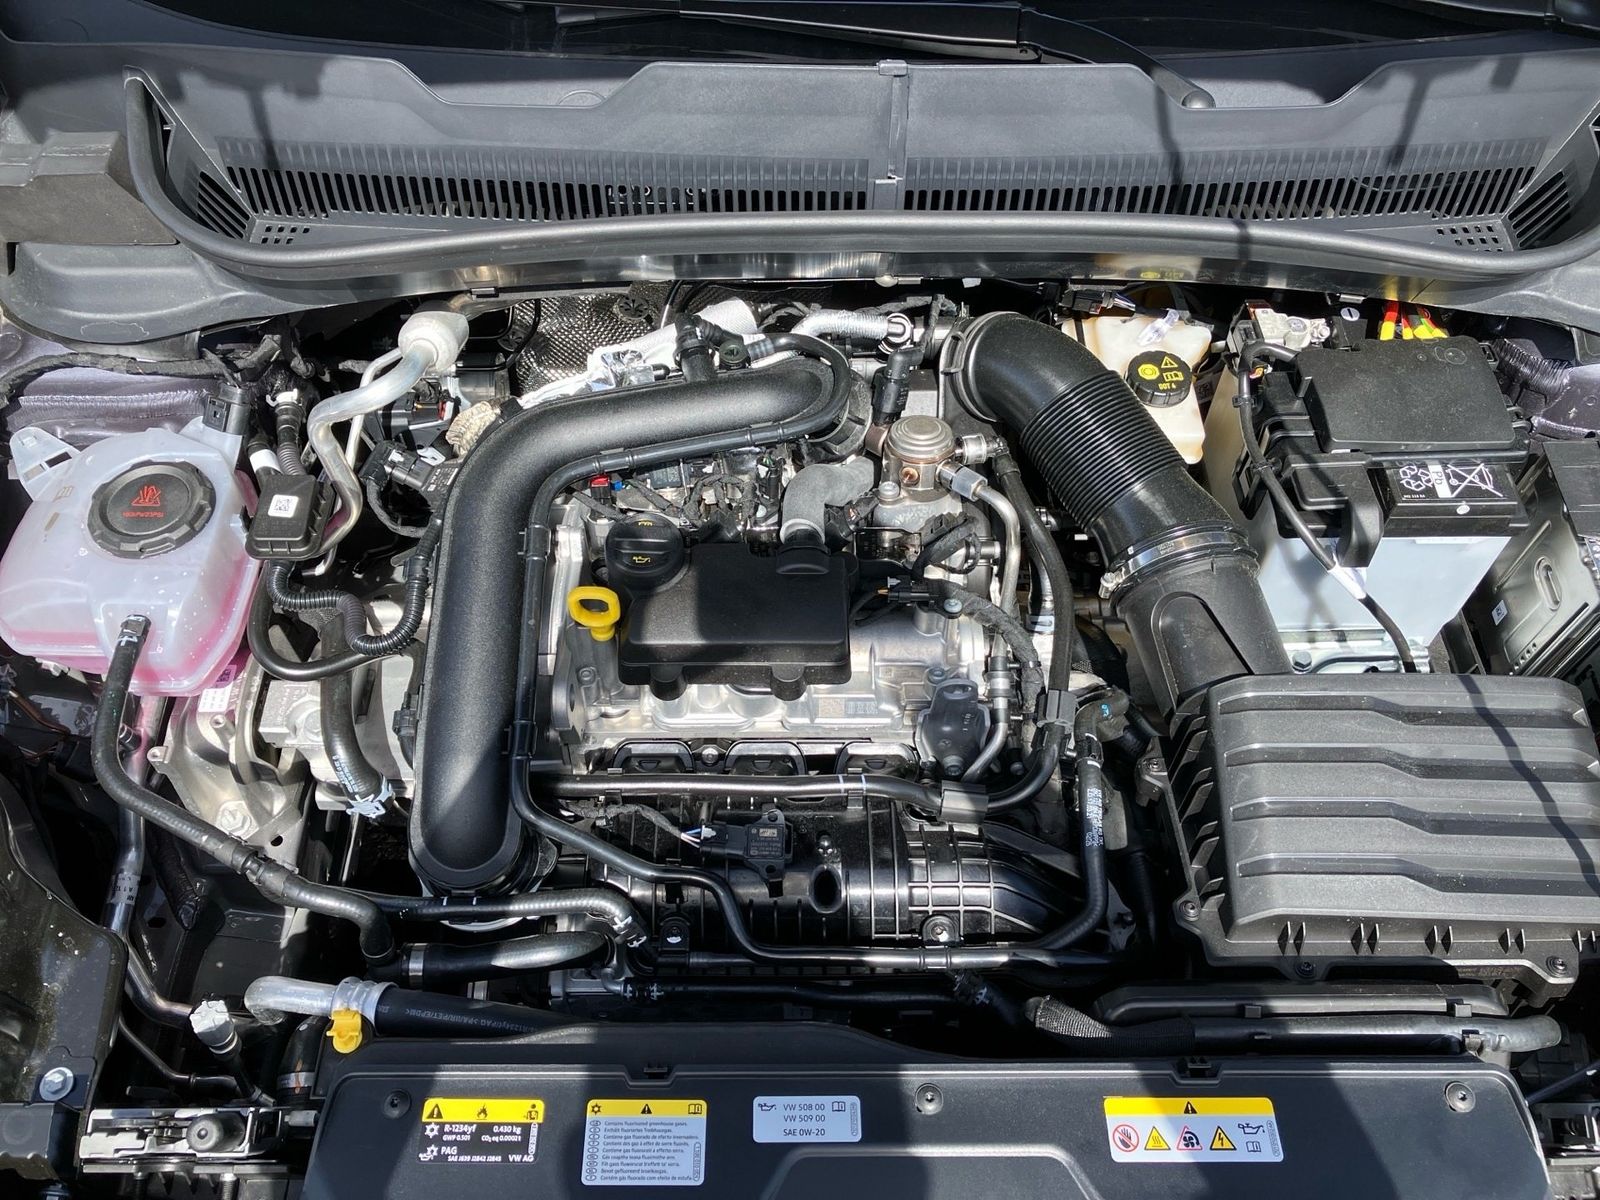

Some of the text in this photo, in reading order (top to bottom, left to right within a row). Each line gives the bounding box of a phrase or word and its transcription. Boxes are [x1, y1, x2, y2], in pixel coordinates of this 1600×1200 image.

[1432, 472, 1443, 485] Pb
[444, 1124, 477, 1133] R-1234yf
[513, 1125, 521, 1134] kg
